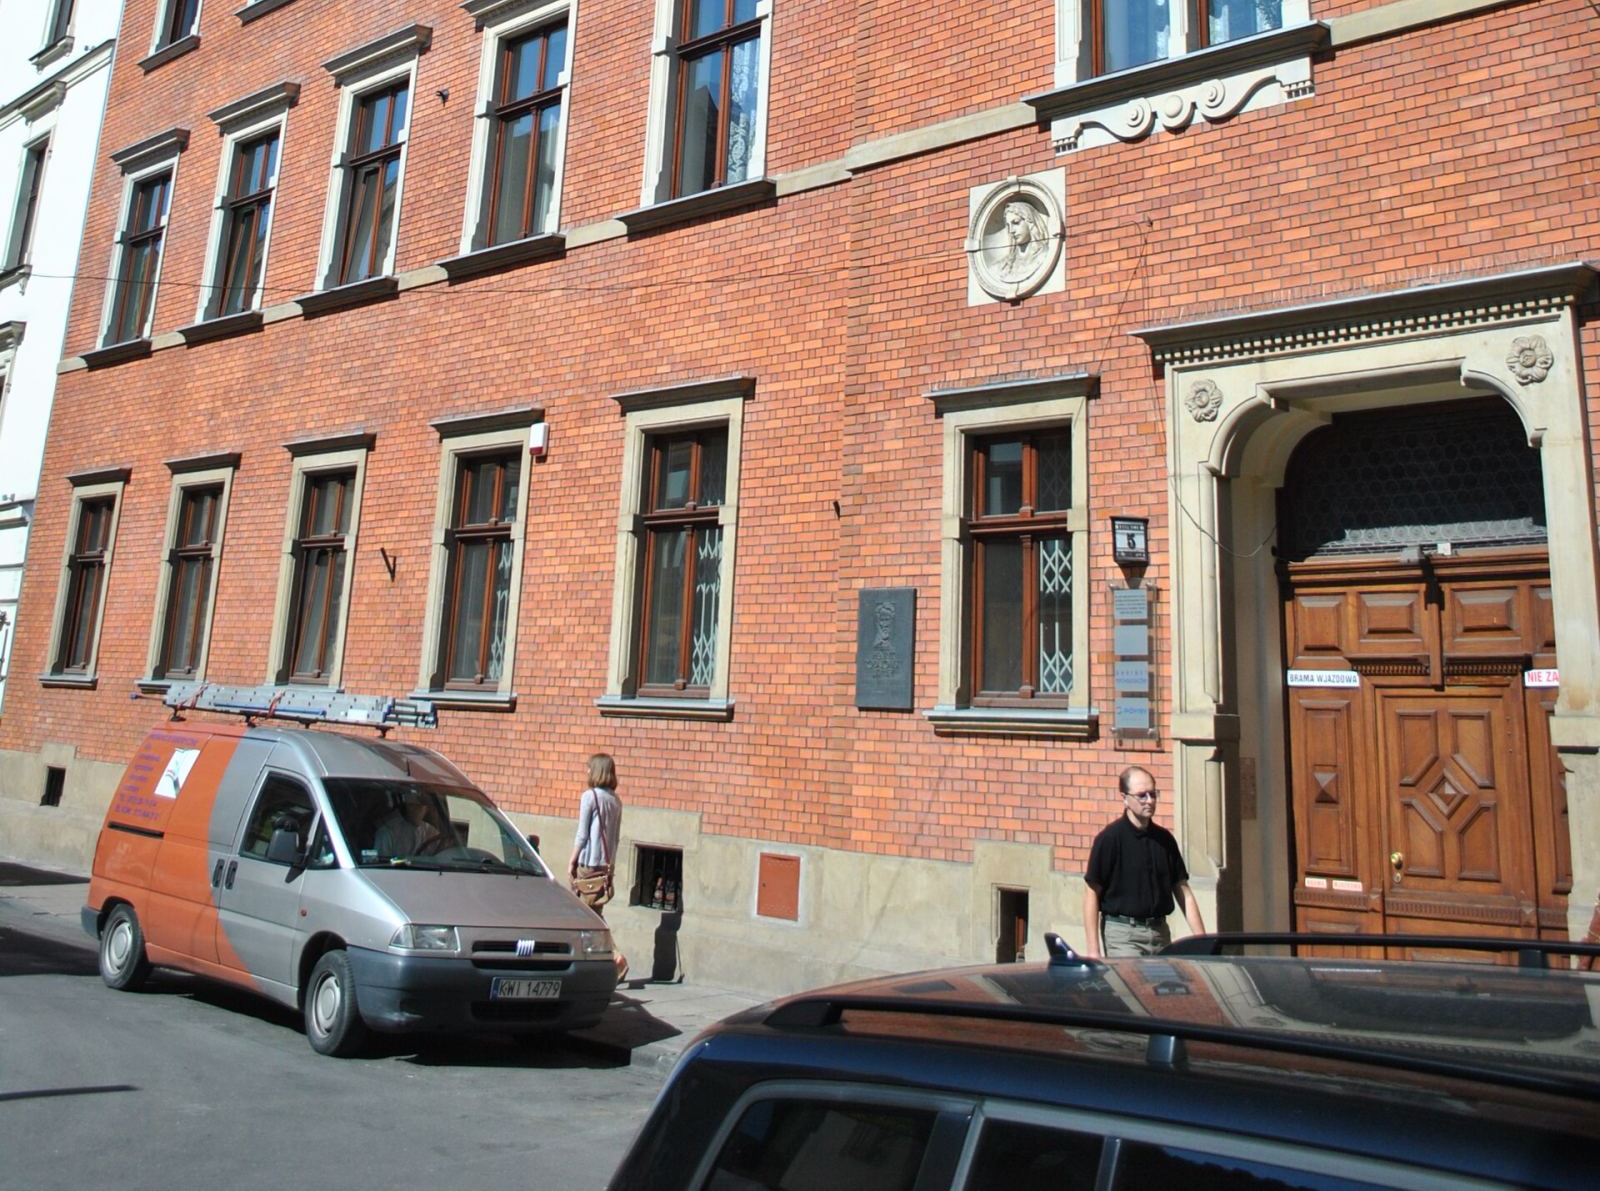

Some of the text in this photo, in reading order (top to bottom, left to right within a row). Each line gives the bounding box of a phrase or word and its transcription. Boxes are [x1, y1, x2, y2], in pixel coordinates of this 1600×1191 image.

[1126, 532, 1136, 550] 5
[1289, 673, 1357, 684] BRAMA WJAZDOWA
[1527, 671, 1543, 683] NIE
[499, 980, 561, 997] KWI 14779
